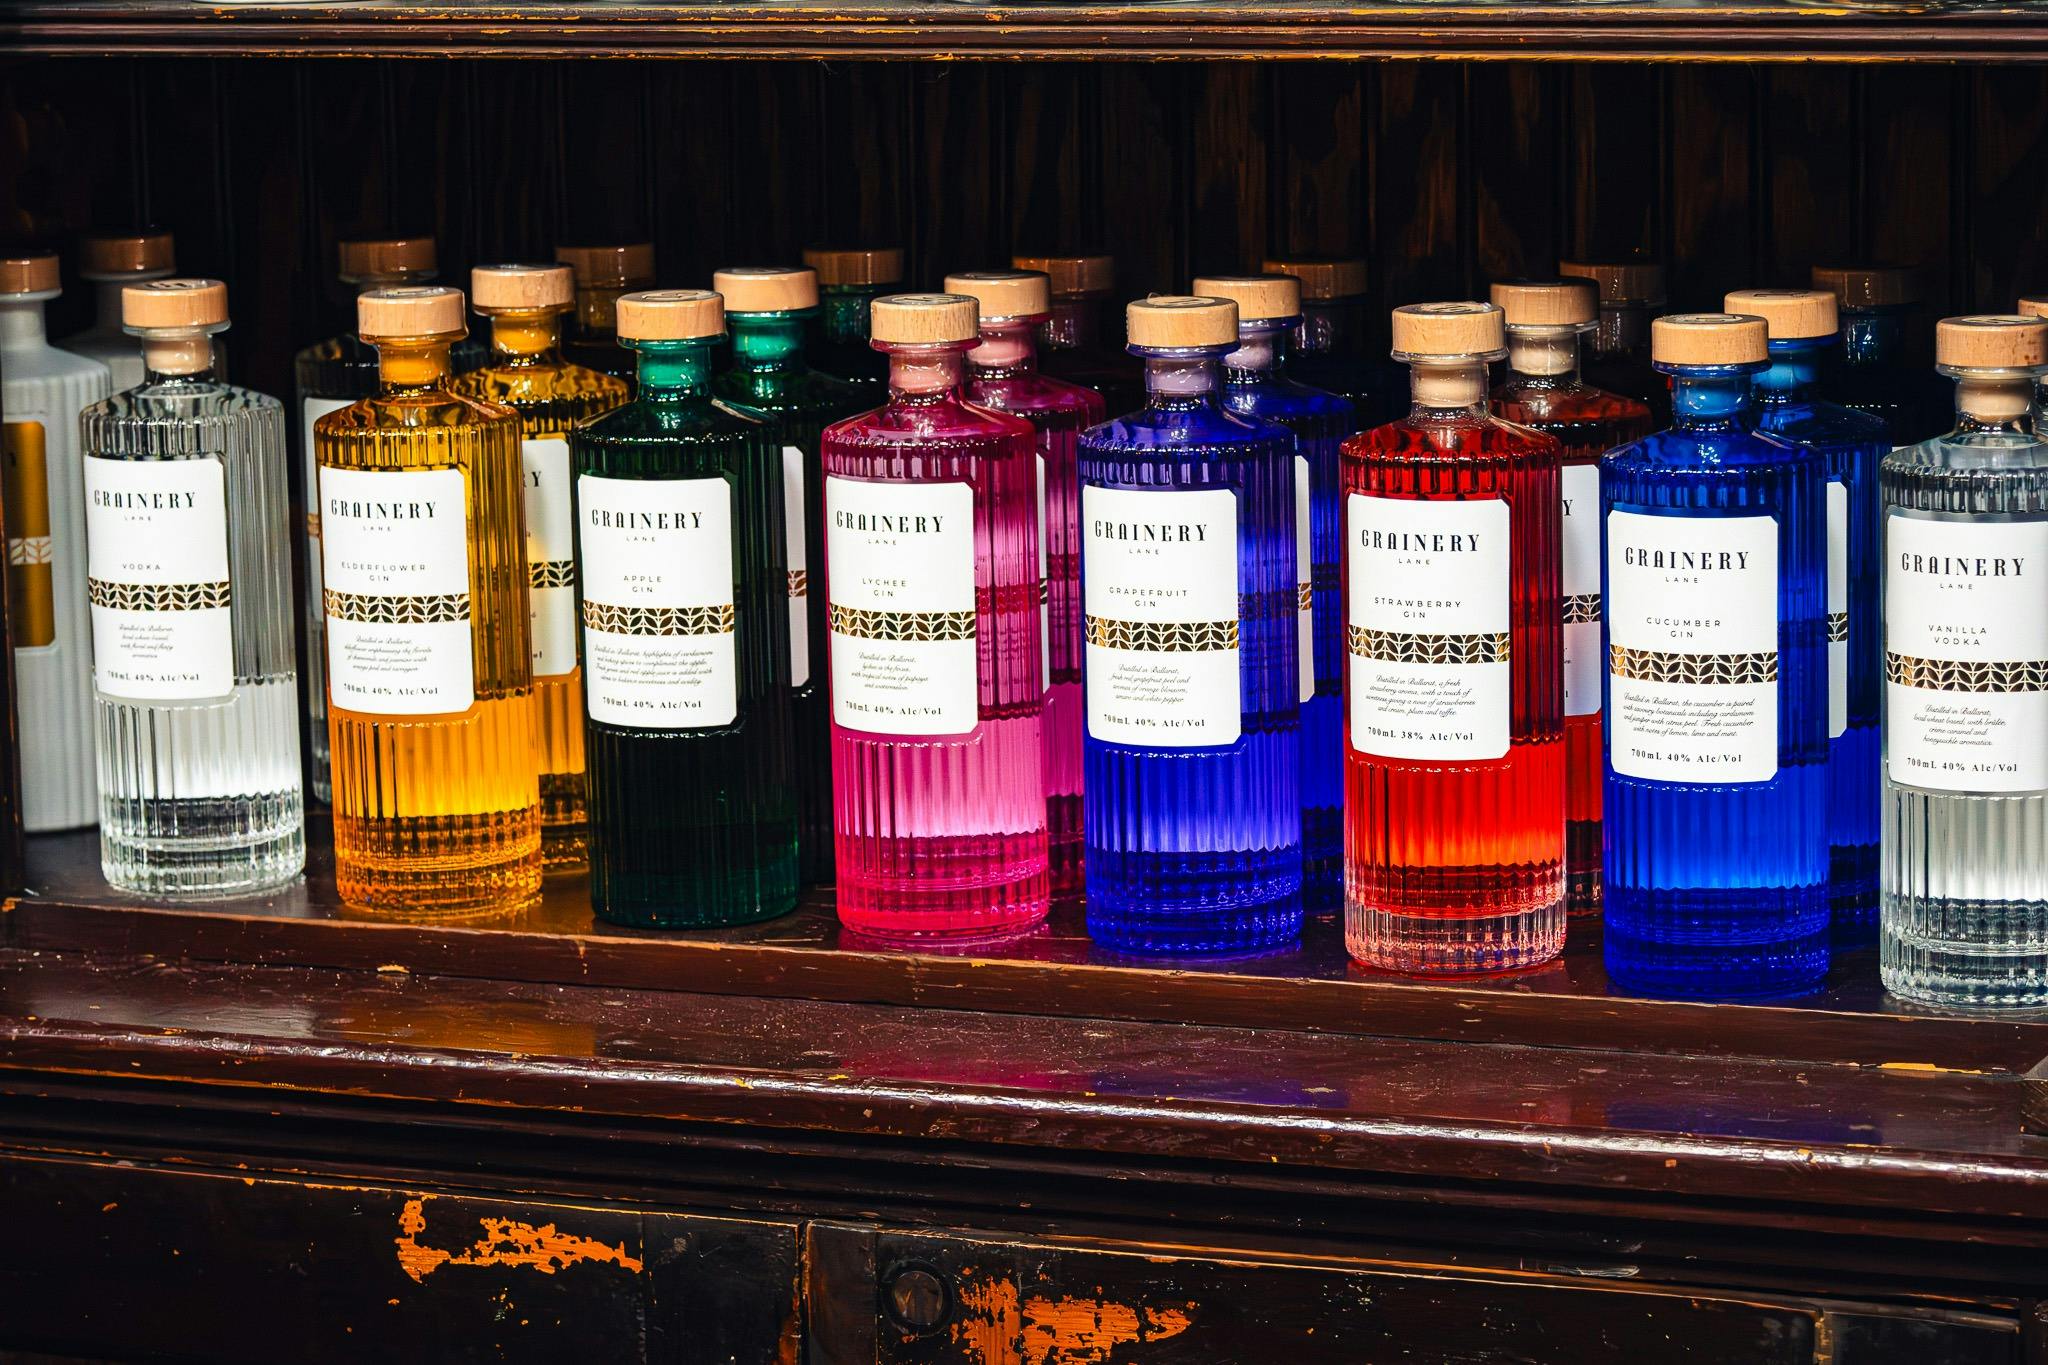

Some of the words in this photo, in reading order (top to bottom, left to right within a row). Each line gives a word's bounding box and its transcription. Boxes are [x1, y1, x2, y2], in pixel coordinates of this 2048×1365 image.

[94, 490, 195, 509] GRAINERY
[331, 499, 436, 519] GRAINERY
[591, 509, 702, 529] GRAINERY
[836, 510, 943, 533] GRAINERY
[1095, 520, 1207, 542] GRAINERY
[1362, 529, 1479, 552] GRAINERY
[1625, 547, 1749, 570] GRAINERY
[1901, 552, 2024, 576] GRAINERY
[123, 563, 160, 571] VODKA
[341, 561, 425, 571] ELDERFLOWER
[862, 578, 906, 587] LYCHEE
[1109, 586, 1188, 597] GRAPEFRUIT
[1374, 597, 1461, 608] STRAWBERRY
[1646, 617, 1721, 627] CUCUMBER
[1670, 630, 1693, 638] GIN
[1929, 624, 1987, 634] VANILLA
[1934, 637, 1980, 645] VODKA
[372, 687, 392, 695] 40%
[398, 687, 438, 695] Alc/Vol
[633, 700, 654, 708] 40%
[660, 700, 702, 709] Alc/Vol
[874, 705, 894, 714] 40%
[900, 707, 942, 715] Alc/Vol
[1104, 714, 1130, 725] 700mL
[1135, 718, 1156, 727] 40%
[1162, 719, 1205, 728] Alc/Vol
[1368, 726, 1396, 738] 700mL
[1401, 731, 1423, 740] 38%
[1429, 733, 1473, 741] Alc/Vol
[1631, 748, 1662, 760] 700mL
[1667, 753, 1691, 762] 40%
[1697, 754, 1742, 763] Alc/Vol
[1907, 757, 1937, 769] 700mL
[1942, 762, 1965, 771] 40%
[1972, 764, 2017, 772] Alc/Vol
